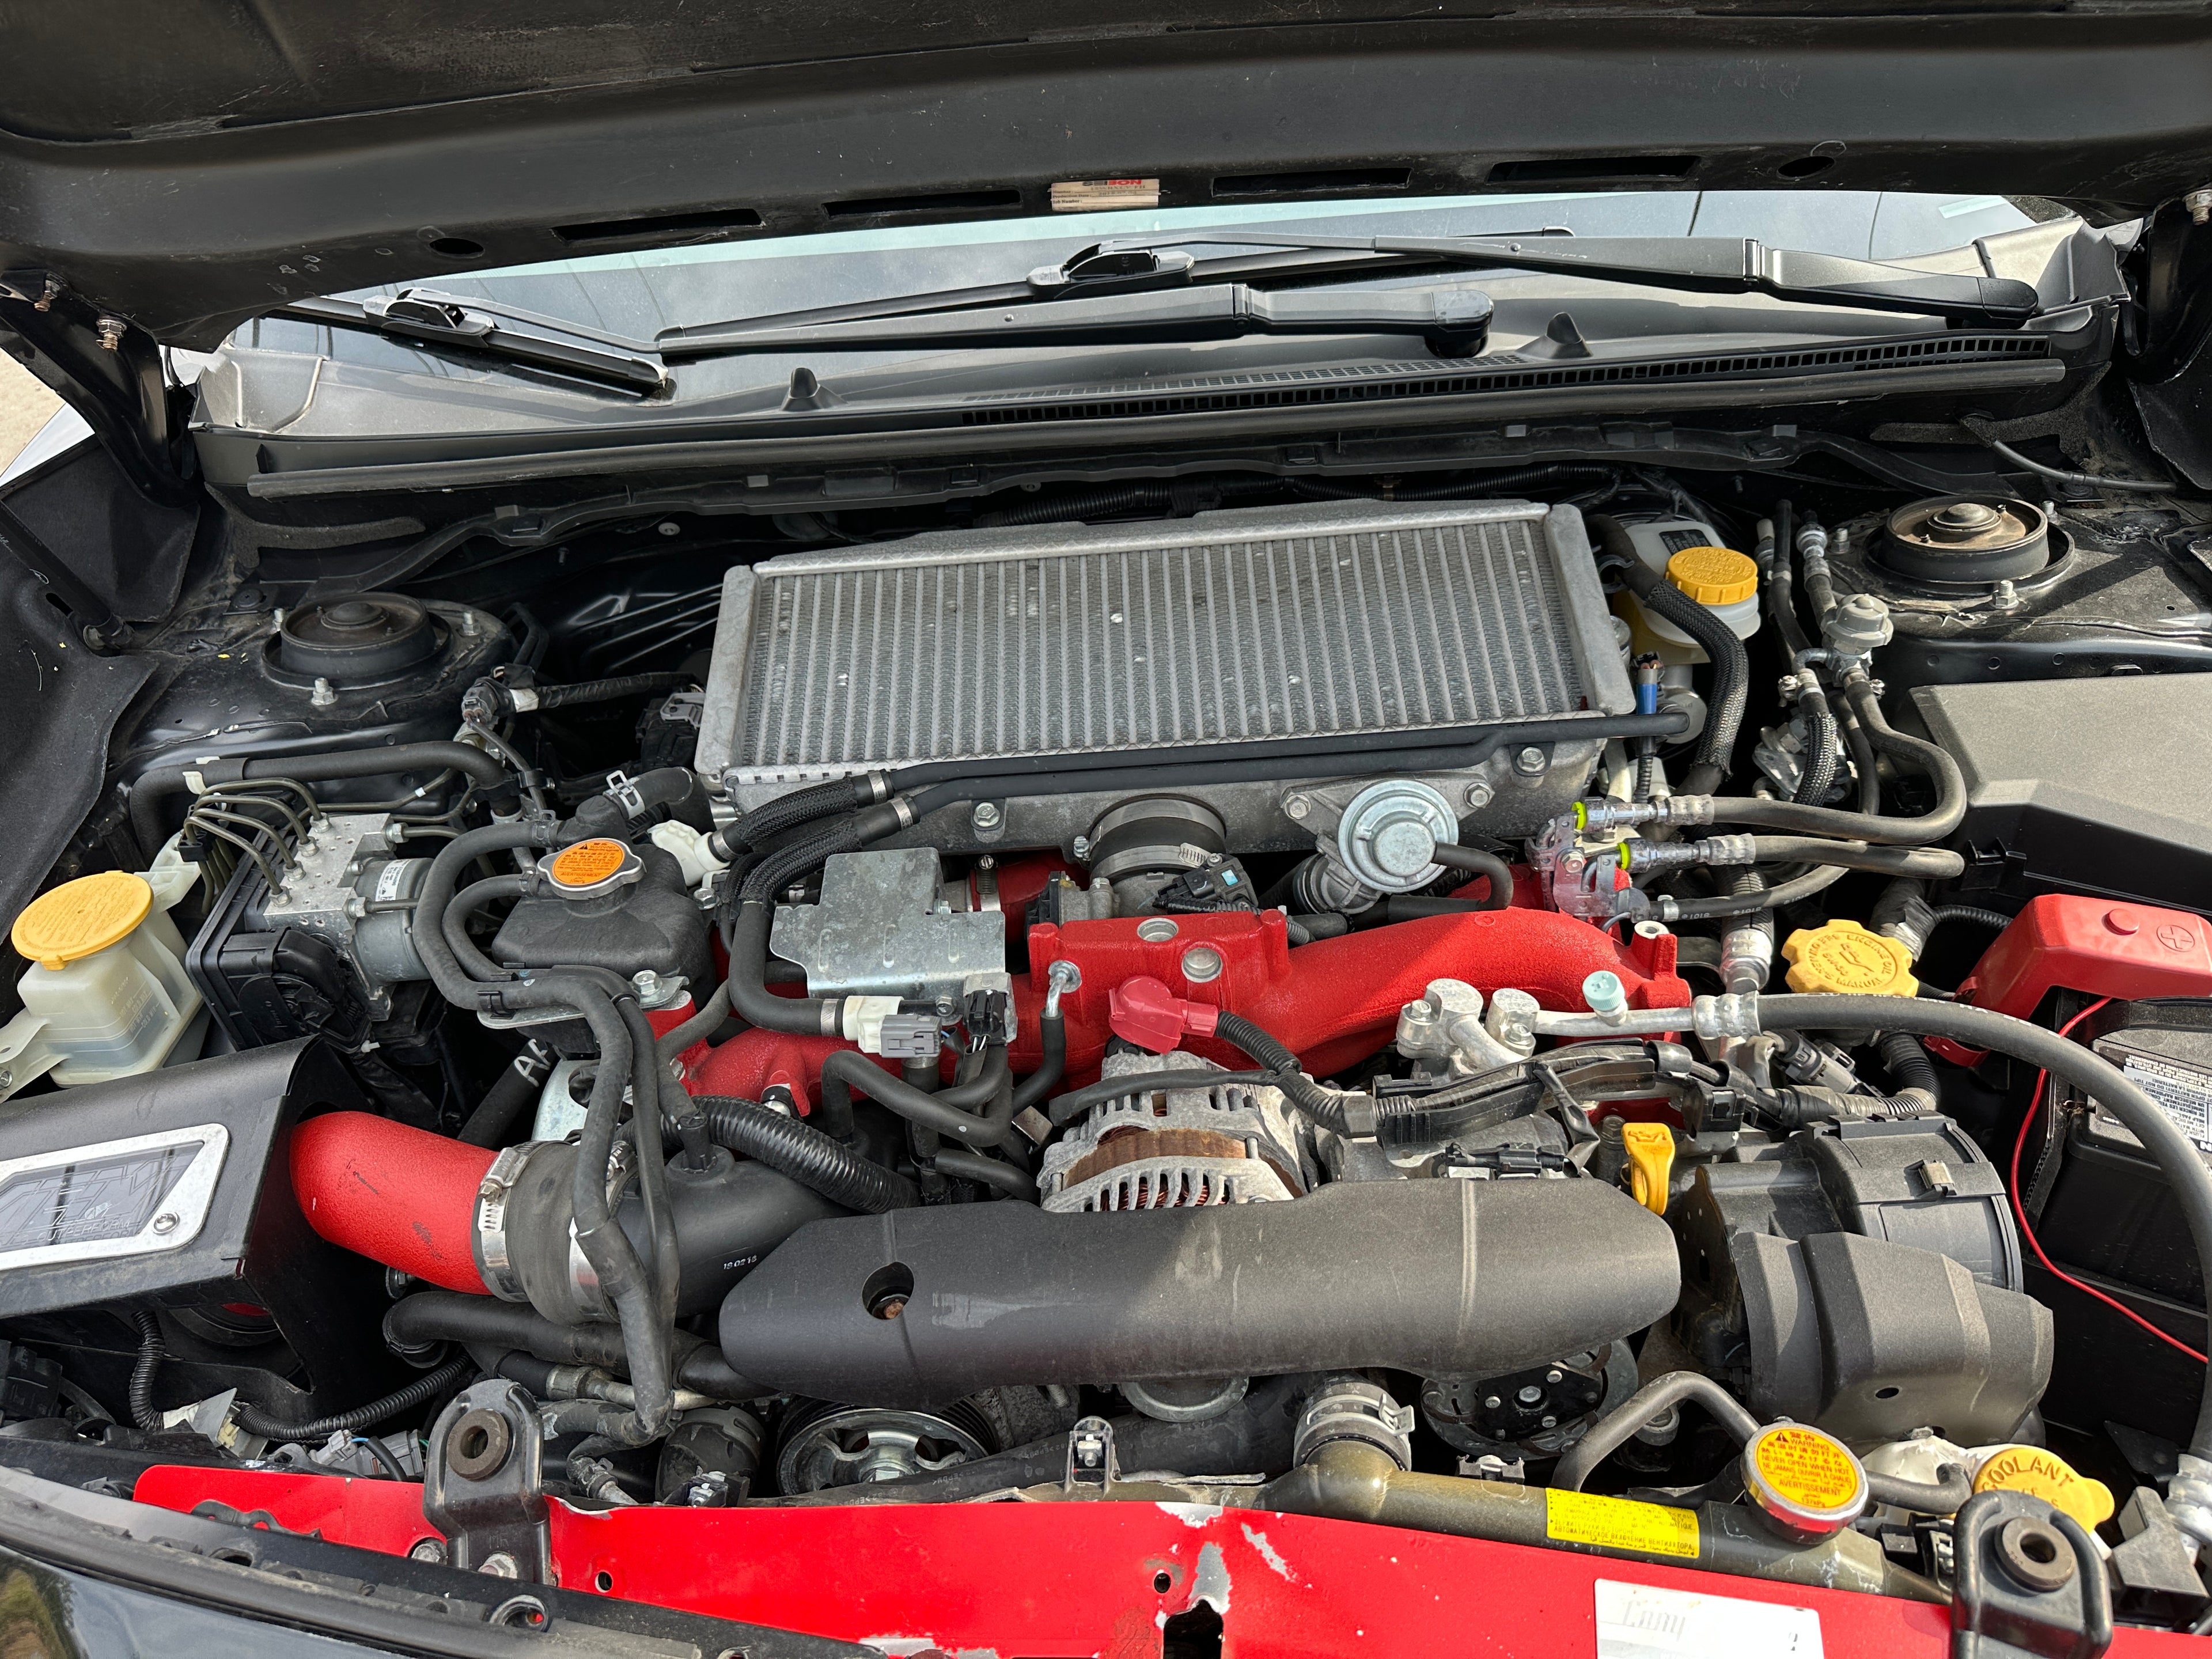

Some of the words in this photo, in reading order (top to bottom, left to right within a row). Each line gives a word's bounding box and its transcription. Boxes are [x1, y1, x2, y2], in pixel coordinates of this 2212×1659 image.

[1846, 934, 1890, 960] ENGINE
[1881, 960, 1892, 975] OIL
[1836, 977, 1883, 988] MANUAL
[37, 1217, 131, 1242] OUTPERFORM
[1790, 1438, 1830, 1450] WARNING
[1762, 1454, 1785, 1464] NEVER
[1787, 1459, 1807, 1468] OPEN
[1809, 1463, 1832, 1472] WHEN
[1835, 1467, 1849, 1475] HOT
[1774, 1464, 1796, 1474] JAMAIS
[1797, 1468, 1821, 1477] OUVRIR
[1982, 1456, 2074, 1492] COOLANT
[1779, 1479, 1840, 1497] AVERTISSEMENT
[1554, 1525, 1608, 1539] АВТОМАТИЧЕСКОЕ
[1611, 1533, 1646, 1544] ВКЛЮЧЕНИЕ
